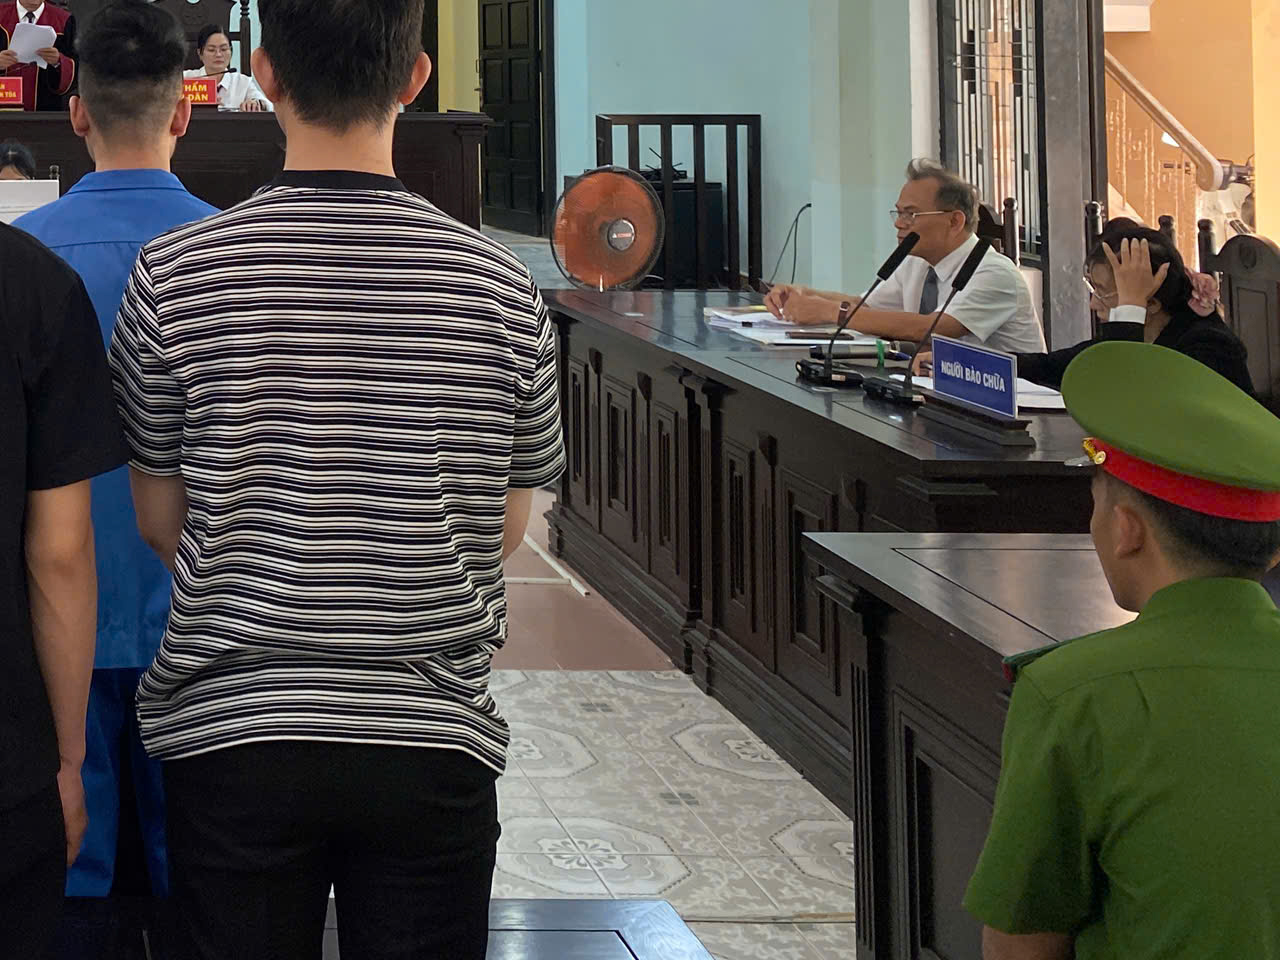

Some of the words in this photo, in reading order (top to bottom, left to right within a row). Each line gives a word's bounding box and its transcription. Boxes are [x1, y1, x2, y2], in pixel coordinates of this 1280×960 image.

[184, 80, 207, 92] HẨM
[941, 360, 964, 380] NGƯỜI
[982, 372, 1005, 392] CHỮA
